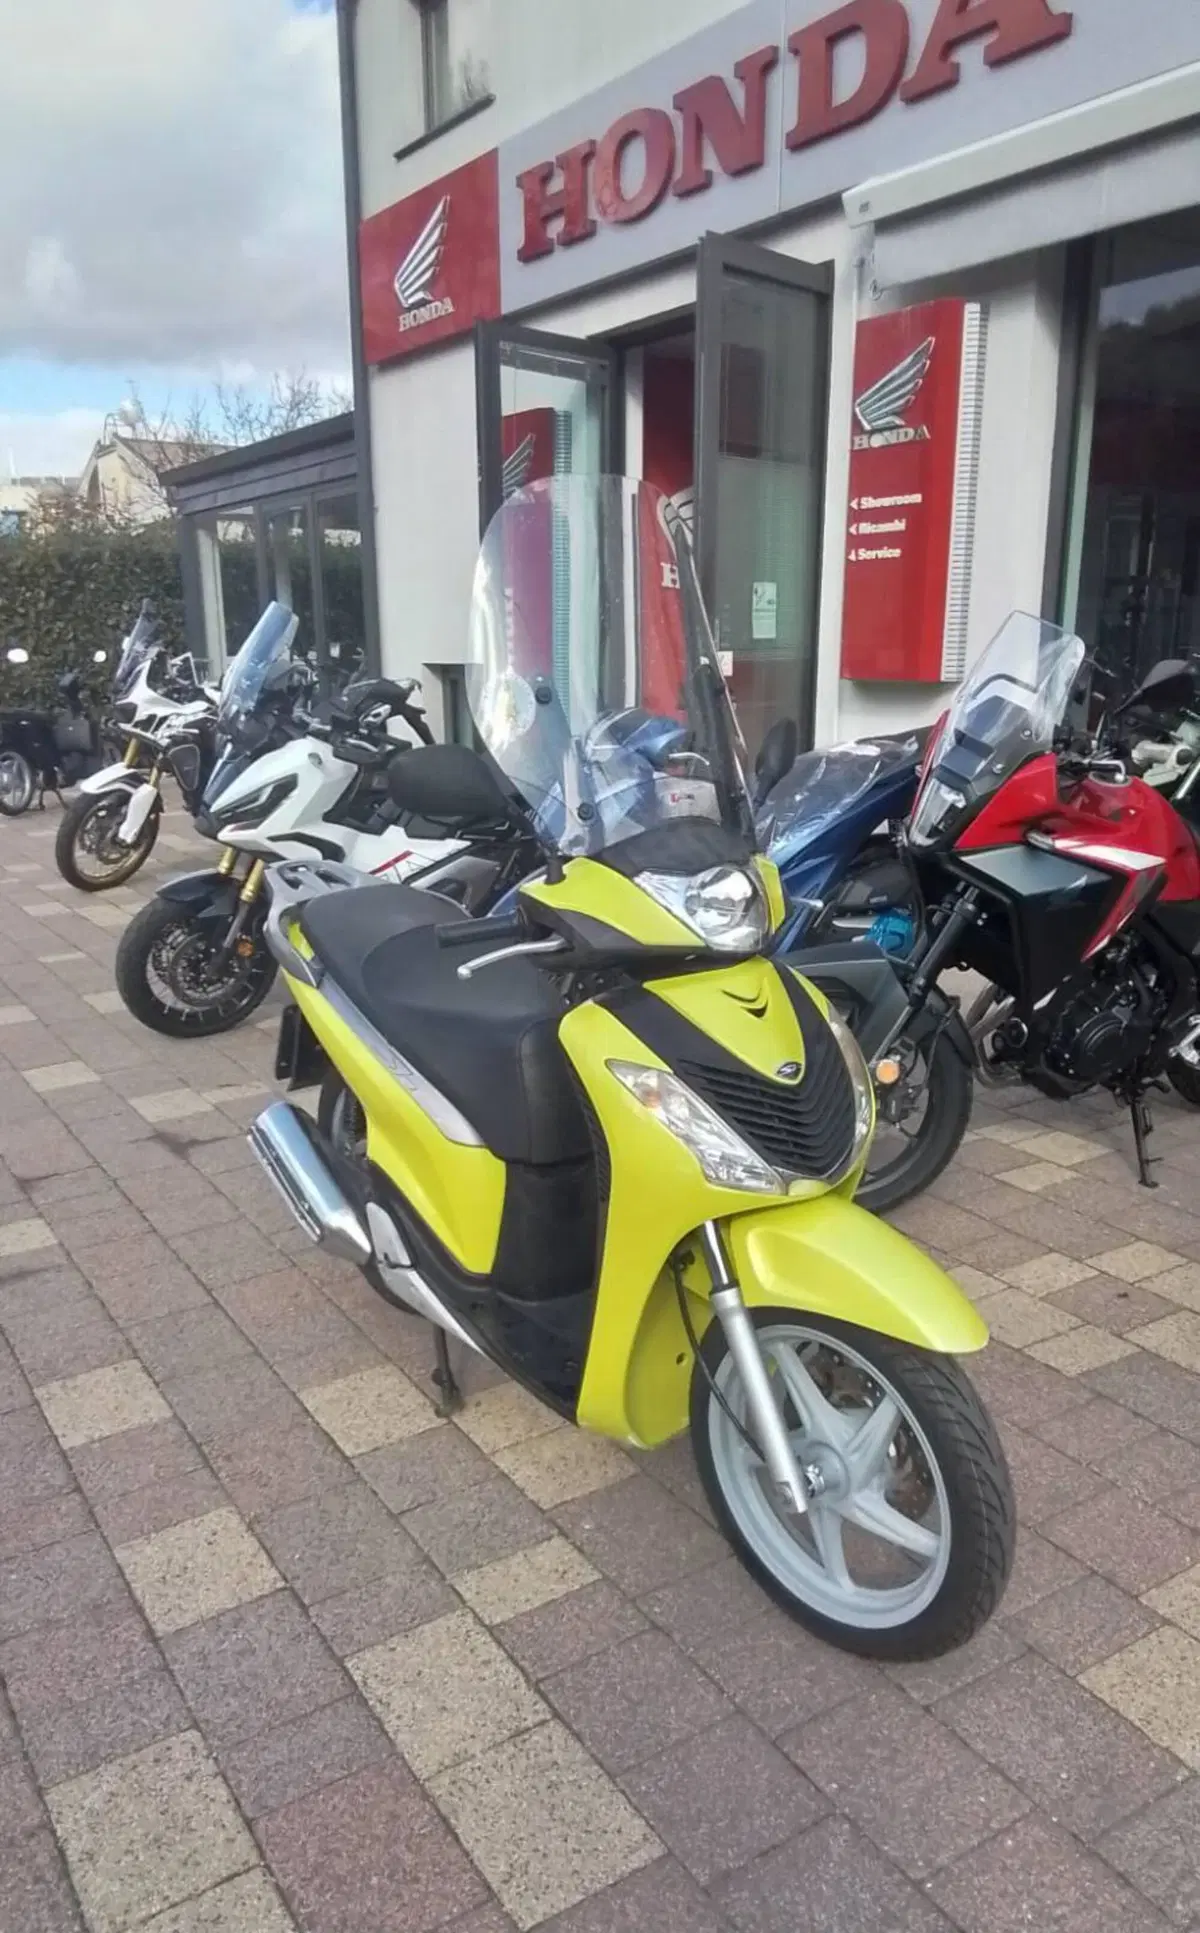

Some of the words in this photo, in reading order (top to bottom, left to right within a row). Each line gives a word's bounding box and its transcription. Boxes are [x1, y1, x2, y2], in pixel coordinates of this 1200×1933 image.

[516, 0, 1073, 263] HONDA
[399, 296, 456, 332] HONDA
[853, 424, 931, 450] HONDA
[860, 493, 922, 510] Showroom
[857, 546, 901, 560] Service
